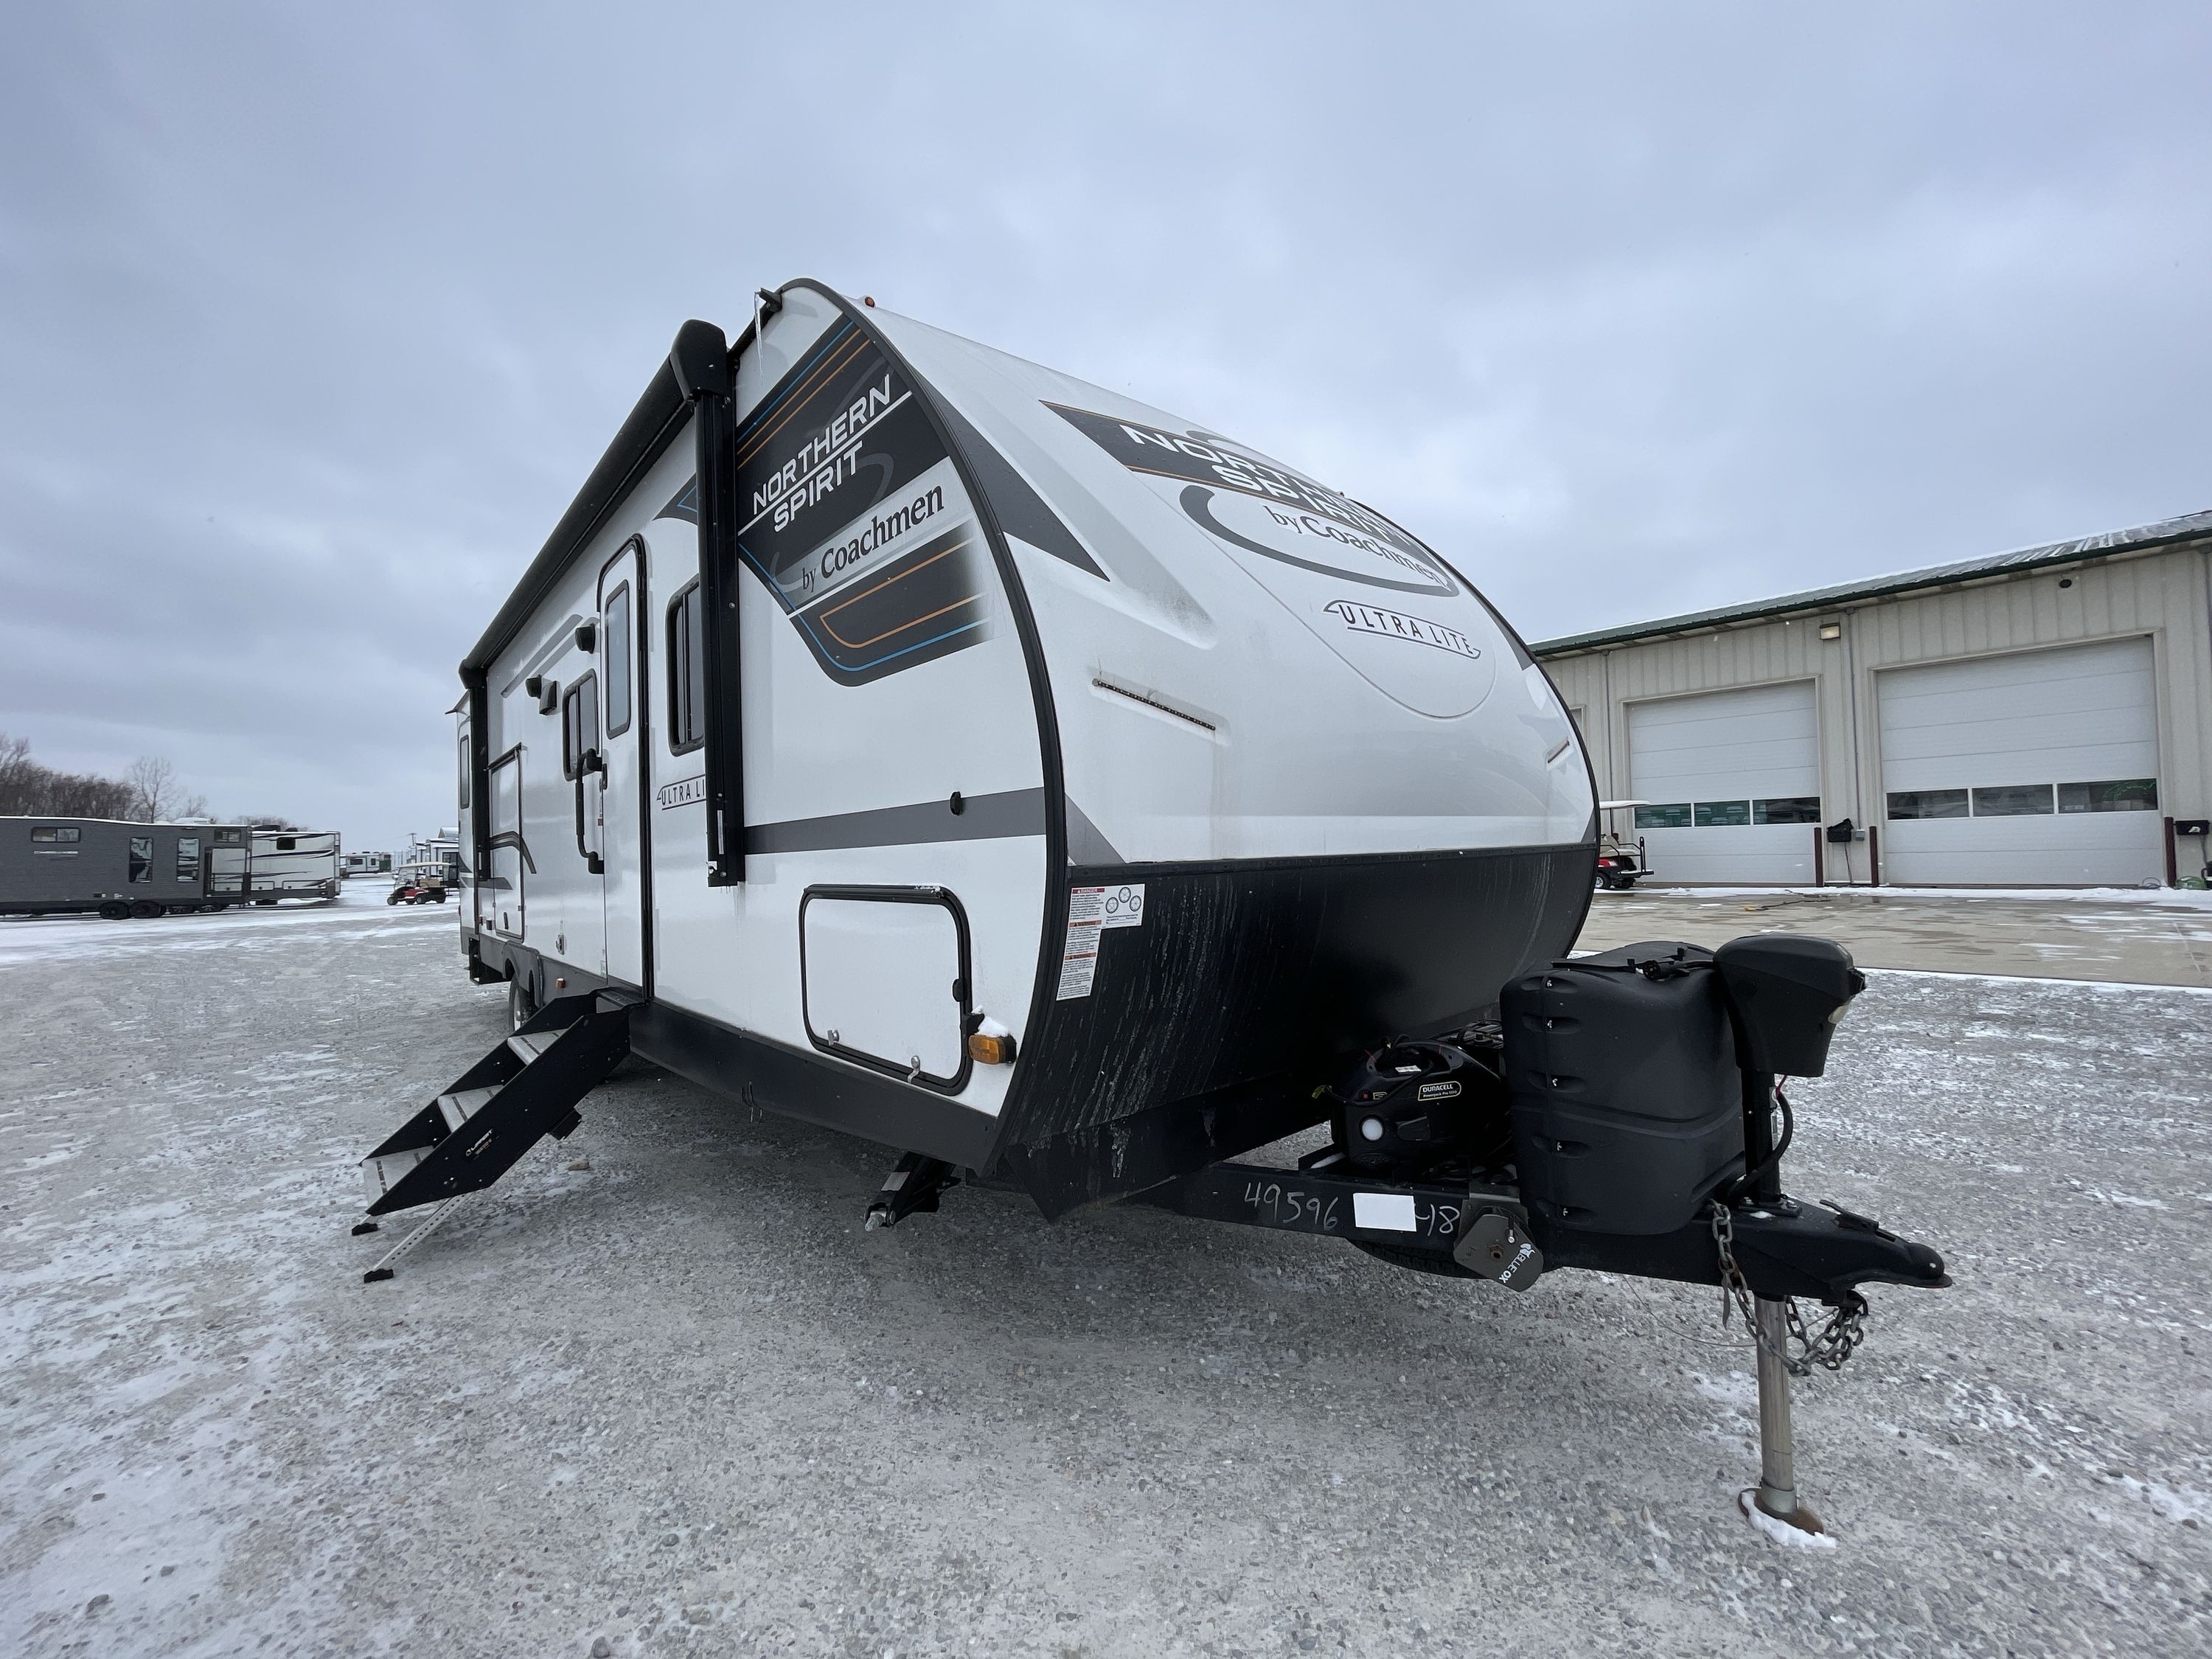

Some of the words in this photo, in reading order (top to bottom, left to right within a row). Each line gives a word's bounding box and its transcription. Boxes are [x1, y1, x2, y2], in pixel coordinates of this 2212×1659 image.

[754, 374, 890, 515] NORTHERN
[774, 440, 863, 532] SPIRIT
[1211, 465, 1392, 543] SPIRIT
[802, 567, 816, 593] by
[821, 485, 945, 579] Coachmen
[1262, 505, 1302, 534] by
[1300, 516, 1447, 588] Coachmen
[1338, 604, 1424, 639] ULTRA
[1429, 625, 1473, 655] LITE
[661, 783, 691, 805] ULTRA
[1422, 1084, 1453, 1093] DURACELL
[1244, 1181, 1339, 1231] 49596
[1498, 1270, 1512, 1284] OX
[1508, 1253, 1526, 1273] BLUE
